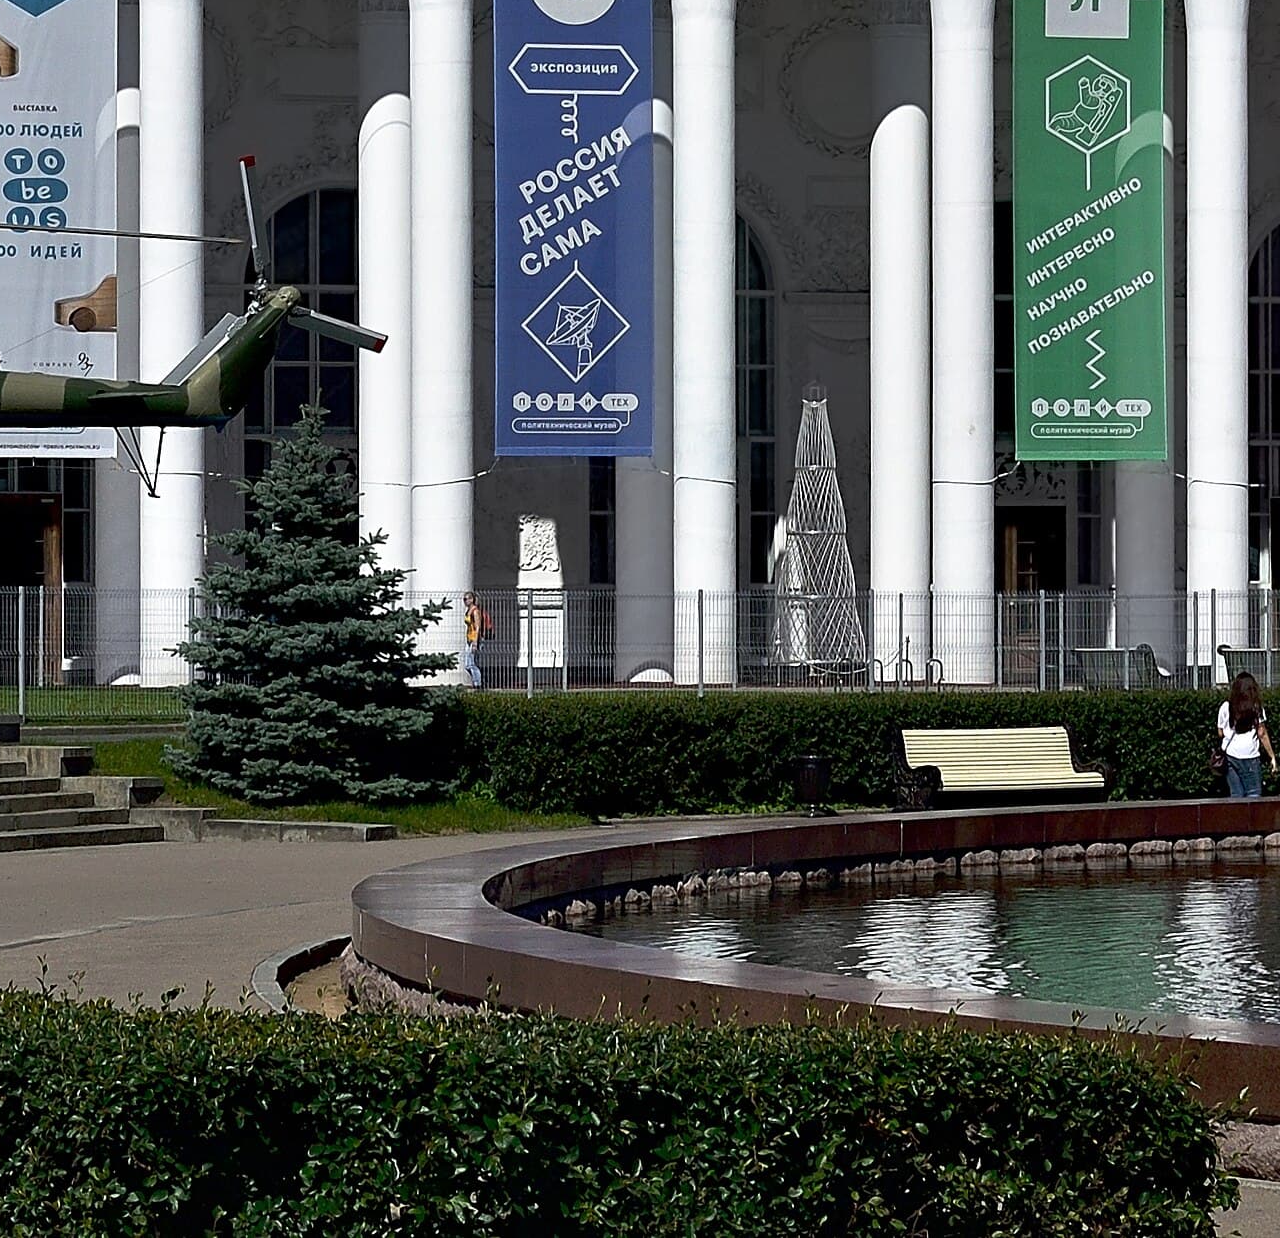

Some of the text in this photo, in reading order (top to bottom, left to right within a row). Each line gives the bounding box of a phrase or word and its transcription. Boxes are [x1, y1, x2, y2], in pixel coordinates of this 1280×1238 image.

[12, 104, 58, 112] ВЫСТАВКА
[19, 122, 83, 139] ЛЮДЕЙ
[20, 180, 52, 200] be
[519, 126, 632, 204] РОССИЯ
[519, 164, 621, 245] ДЕЛАЕТ
[1026, 177, 1142, 254] ИНТЕРАКТИВНО
[30, 243, 83, 260] ИДЕЙ
[520, 218, 602, 275] САМА
[1026, 227, 1116, 288] ИНТЕРЕСНО
[1027, 278, 1088, 321] НАУЧНО
[1027, 270, 1155, 354] ПОЗНАВАТЕЛЬНО
